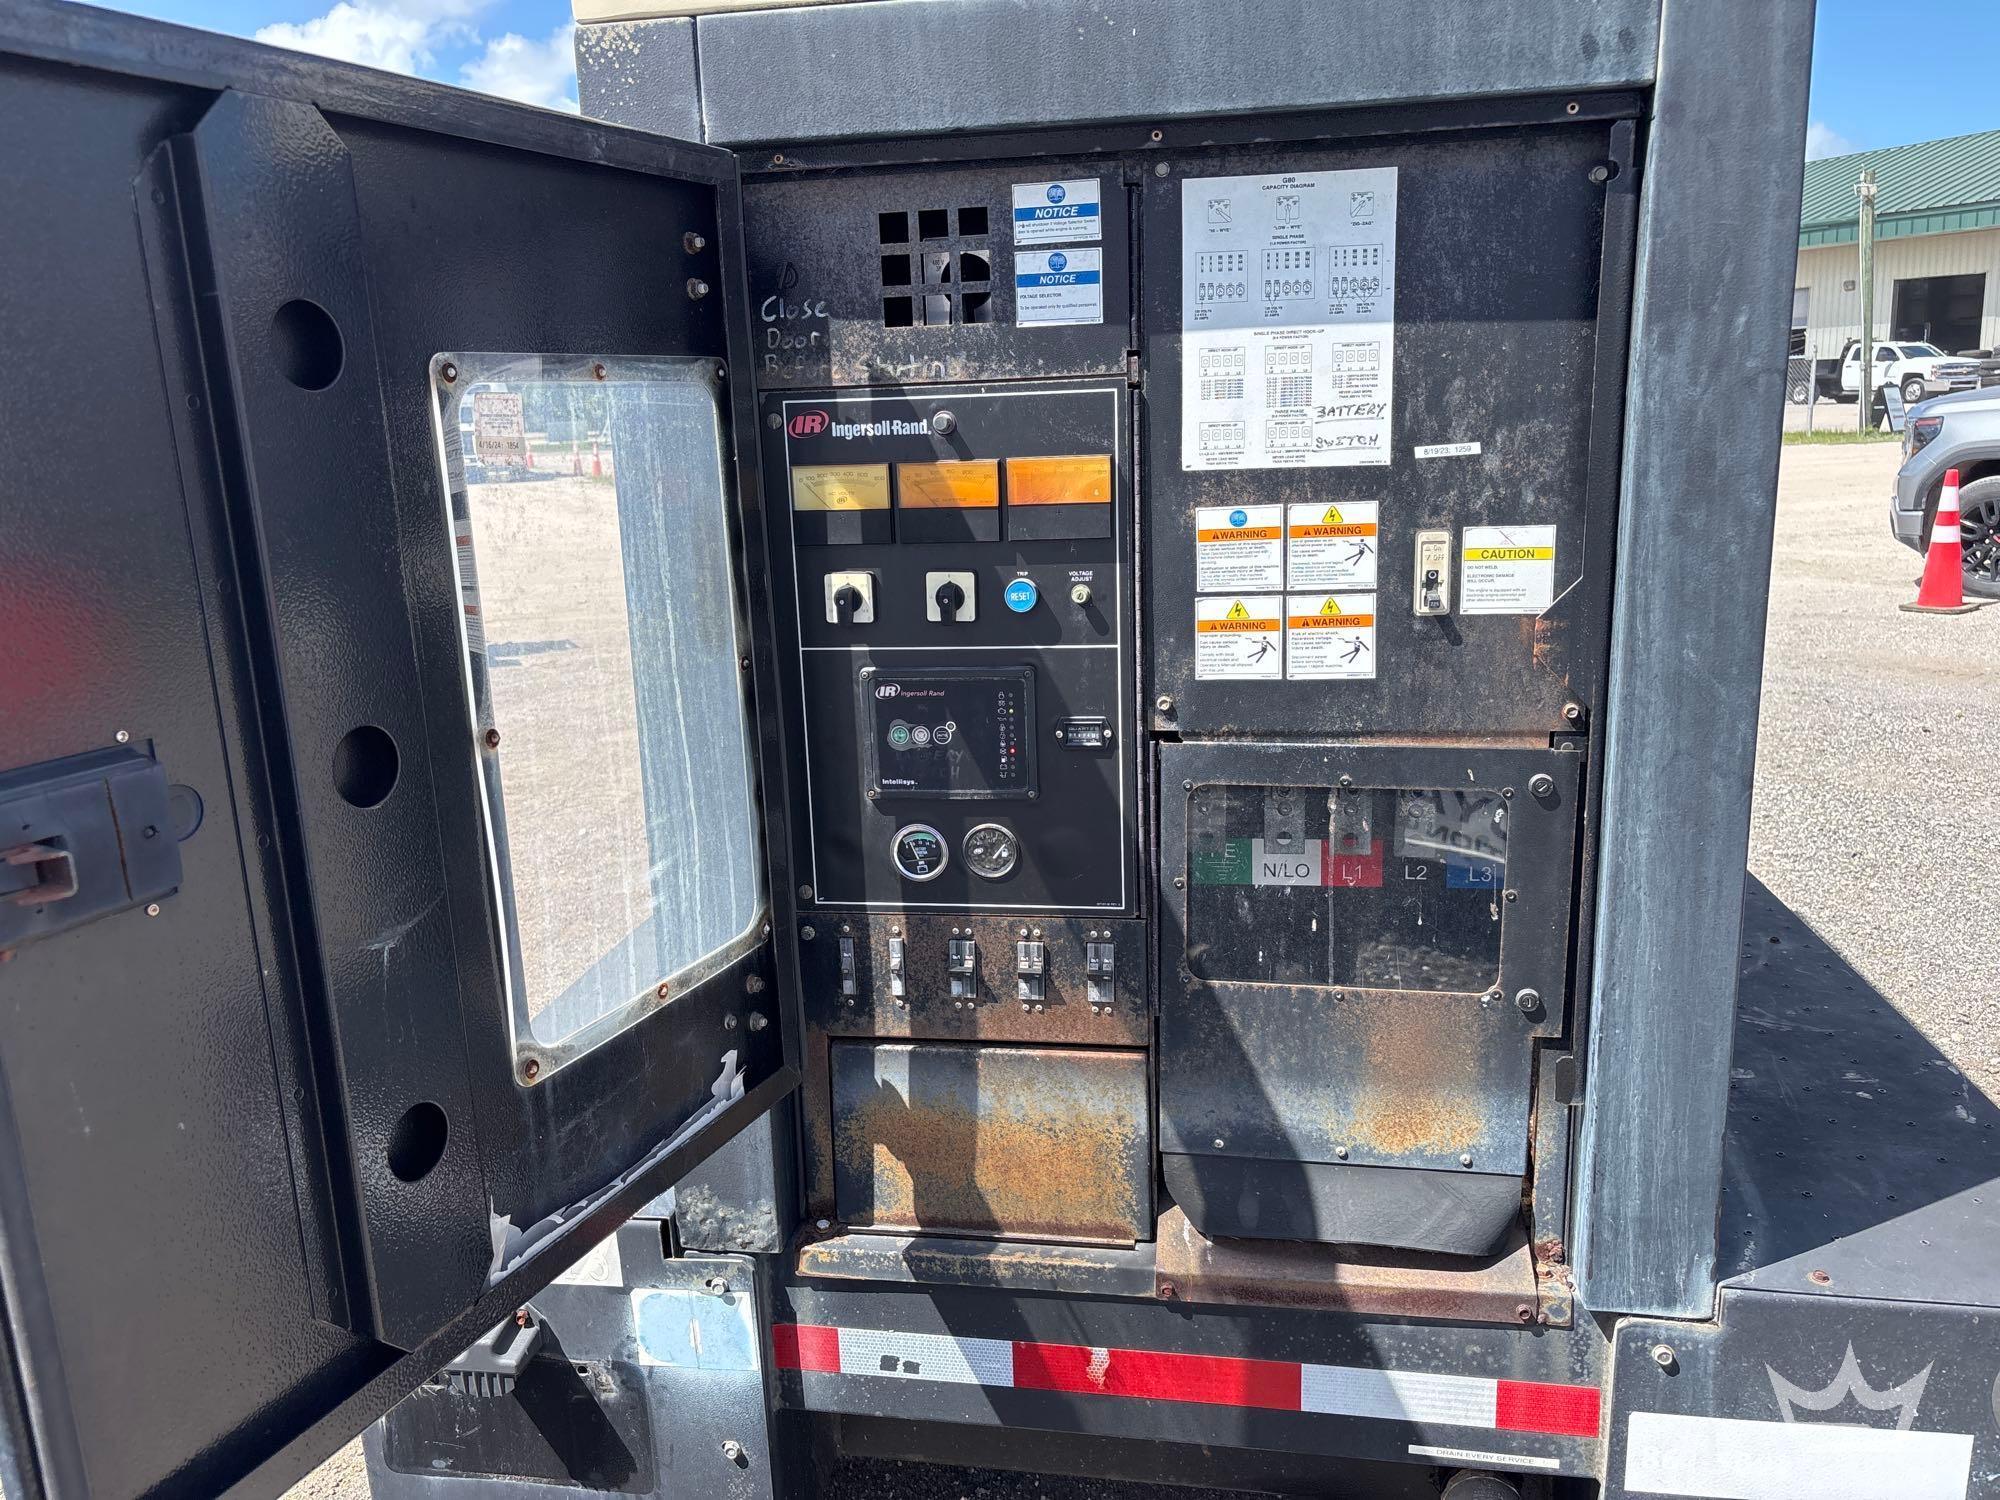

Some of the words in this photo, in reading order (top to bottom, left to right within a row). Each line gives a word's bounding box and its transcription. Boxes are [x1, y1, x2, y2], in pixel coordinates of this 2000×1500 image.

[1034, 206, 1079, 218] NOTICE
[1040, 274, 1076, 284] NOTICE
[761, 295, 831, 322] Close
[767, 327, 821, 349] Door
[1314, 403, 1387, 418] BATTERY
[793, 413, 824, 435] IR
[1316, 434, 1378, 449] SWITCH
[1220, 530, 1267, 539] WARNING
[1314, 526, 1361, 535] WARNING
[1481, 549, 1535, 559] CAUTION
[1011, 592, 1030, 601] RESET
[1312, 618, 1360, 626] WARNING
[878, 685, 898, 698] IR
[1263, 863, 1310, 878] N/LO
[1342, 864, 1362, 880] L1
[1405, 865, 1427, 880] L2
[1469, 866, 1492, 882] L3
[1466, 1452, 1494, 1460] EVERY
[1496, 1456, 1534, 1464] SERVICE
